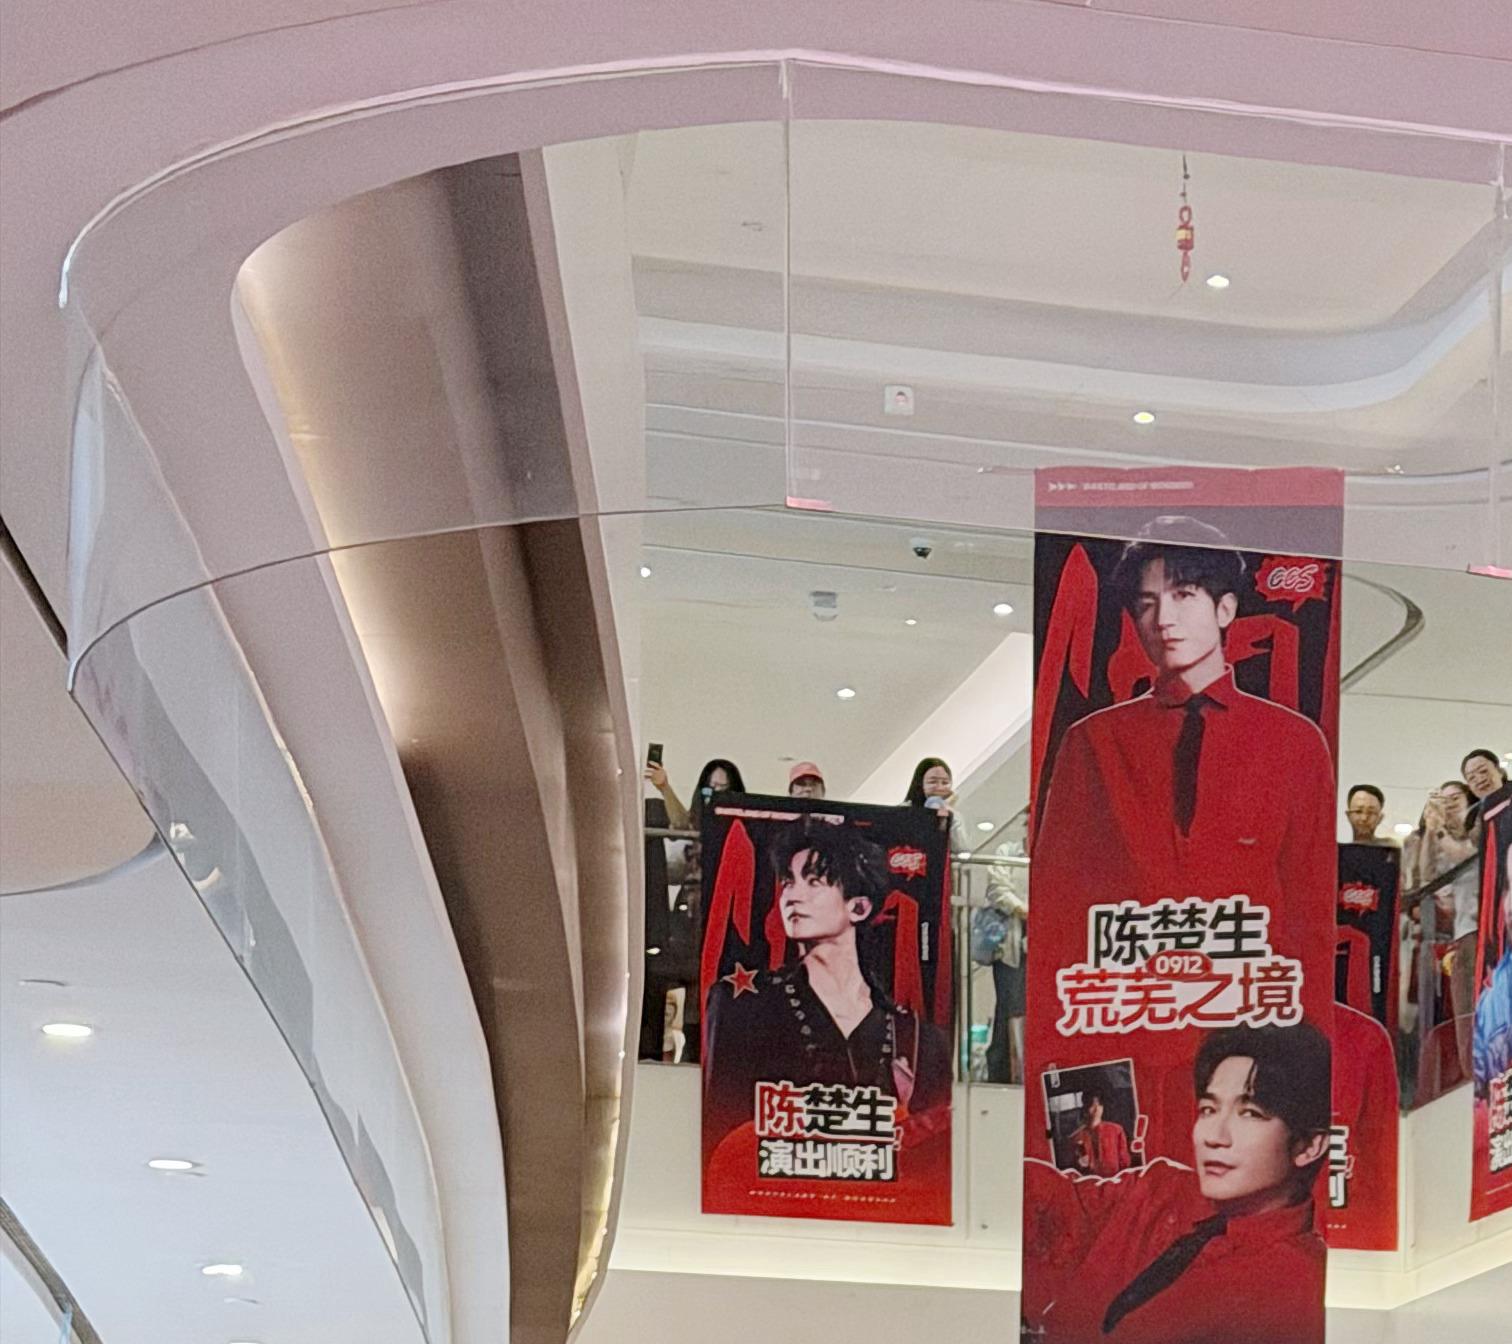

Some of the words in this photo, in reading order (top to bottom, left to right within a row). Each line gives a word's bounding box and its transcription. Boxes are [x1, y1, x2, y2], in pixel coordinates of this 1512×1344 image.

[1091, 899, 1268, 967] 陈楚生
[1061, 962, 1298, 1028] 荒芜之境
[1155, 956, 1203, 974] 0912
[756, 1080, 897, 1141] 陈楚生
[759, 1140, 894, 1179] 演出顺利
